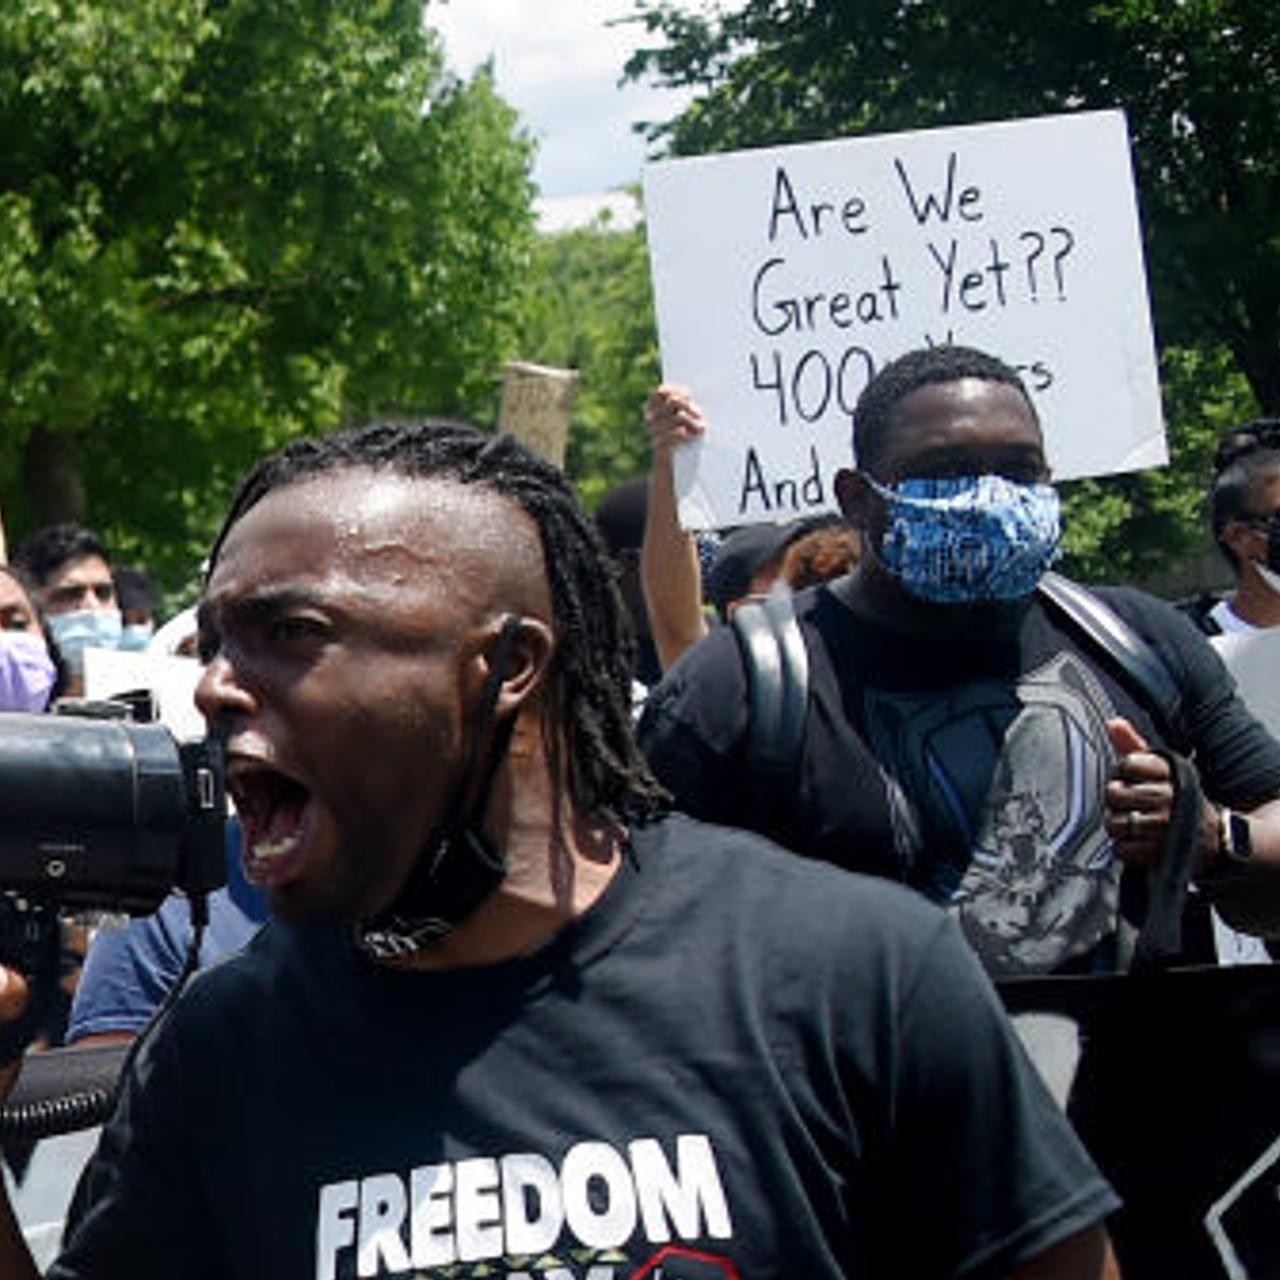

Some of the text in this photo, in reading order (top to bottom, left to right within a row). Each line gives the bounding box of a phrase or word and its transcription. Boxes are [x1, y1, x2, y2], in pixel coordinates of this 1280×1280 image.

[768, 152, 985, 242] Are We
[751, 227, 1074, 337] Great Yet??
[749, 346, 875, 426] 400
[738, 447, 826, 515] And
